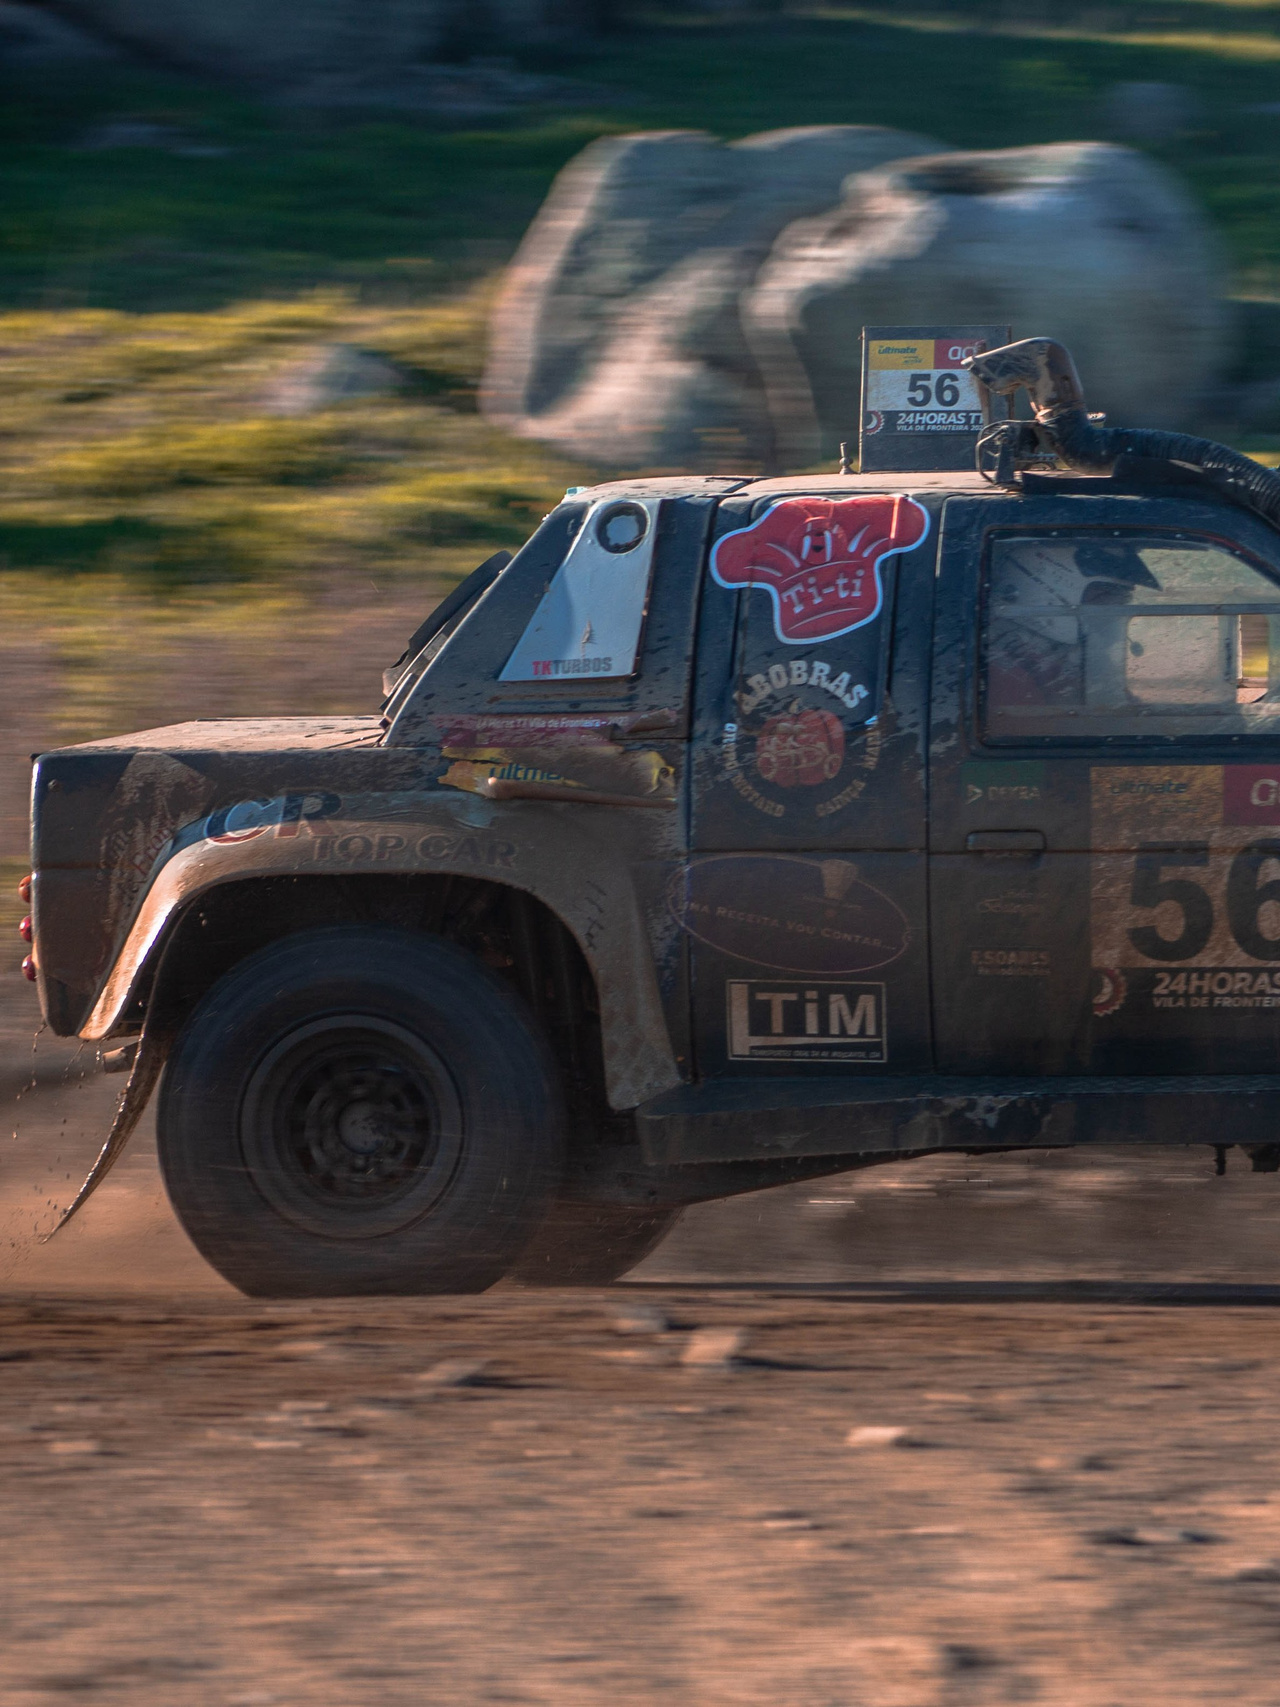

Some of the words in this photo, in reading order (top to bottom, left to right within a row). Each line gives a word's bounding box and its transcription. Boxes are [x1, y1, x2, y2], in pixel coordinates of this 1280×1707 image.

[907, 372, 960, 407] 56
[896, 424, 914, 432] VILA
[915, 424, 926, 432] DE
[926, 424, 969, 432] FRONTEIRA
[311, 834, 406, 863] TOP
[414, 831, 518, 868] CAR
[1153, 996, 1186, 1008] VILA
[1190, 996, 1210, 1008] DE
